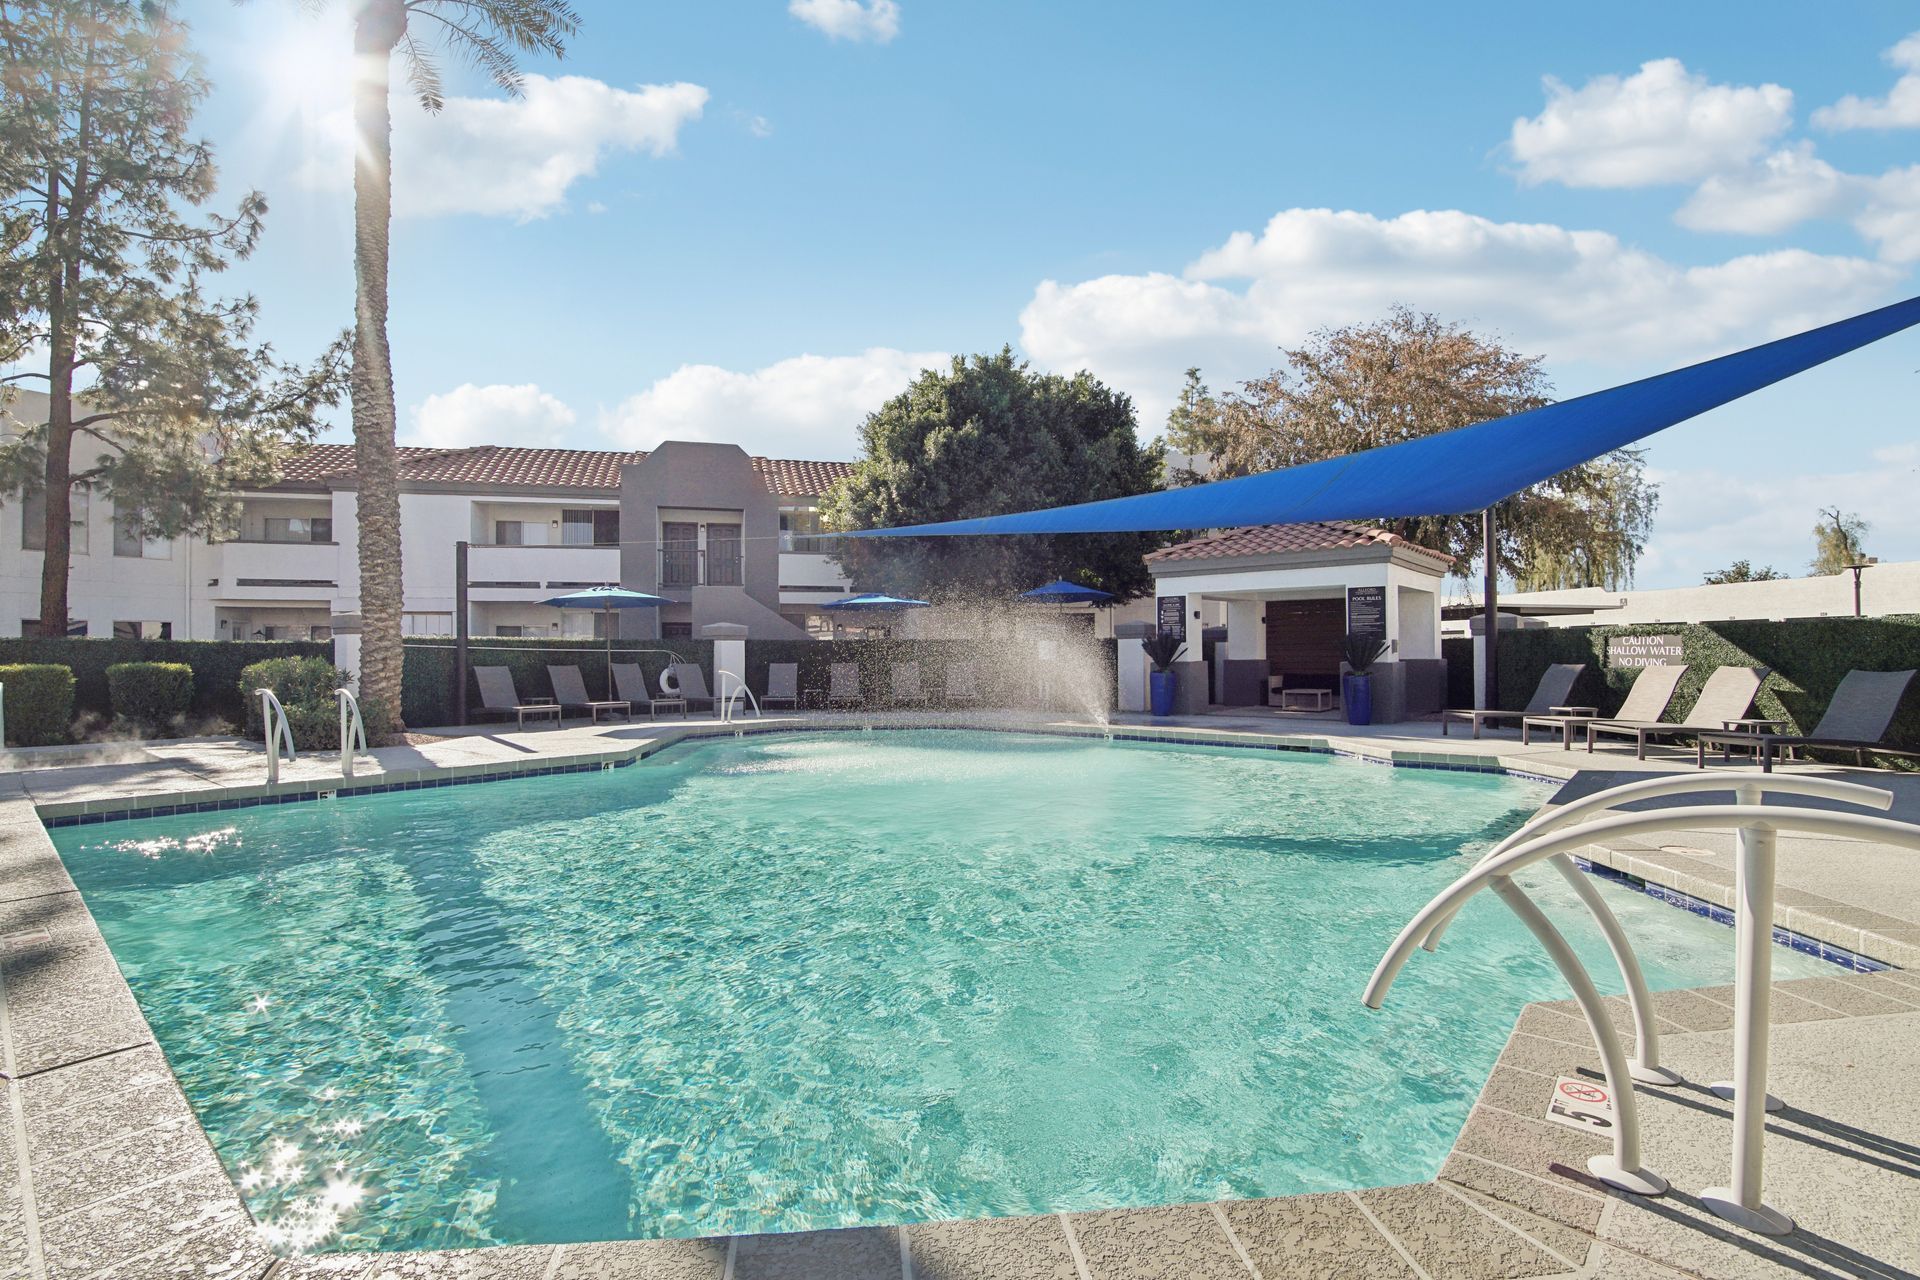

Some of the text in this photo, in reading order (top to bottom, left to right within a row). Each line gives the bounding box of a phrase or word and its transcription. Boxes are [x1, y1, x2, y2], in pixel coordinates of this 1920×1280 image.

[1622, 636, 1664, 645] CAUTION
[1607, 646, 1682, 655] SHALLOW WATER
[1618, 657, 1667, 666] NO DIVING
